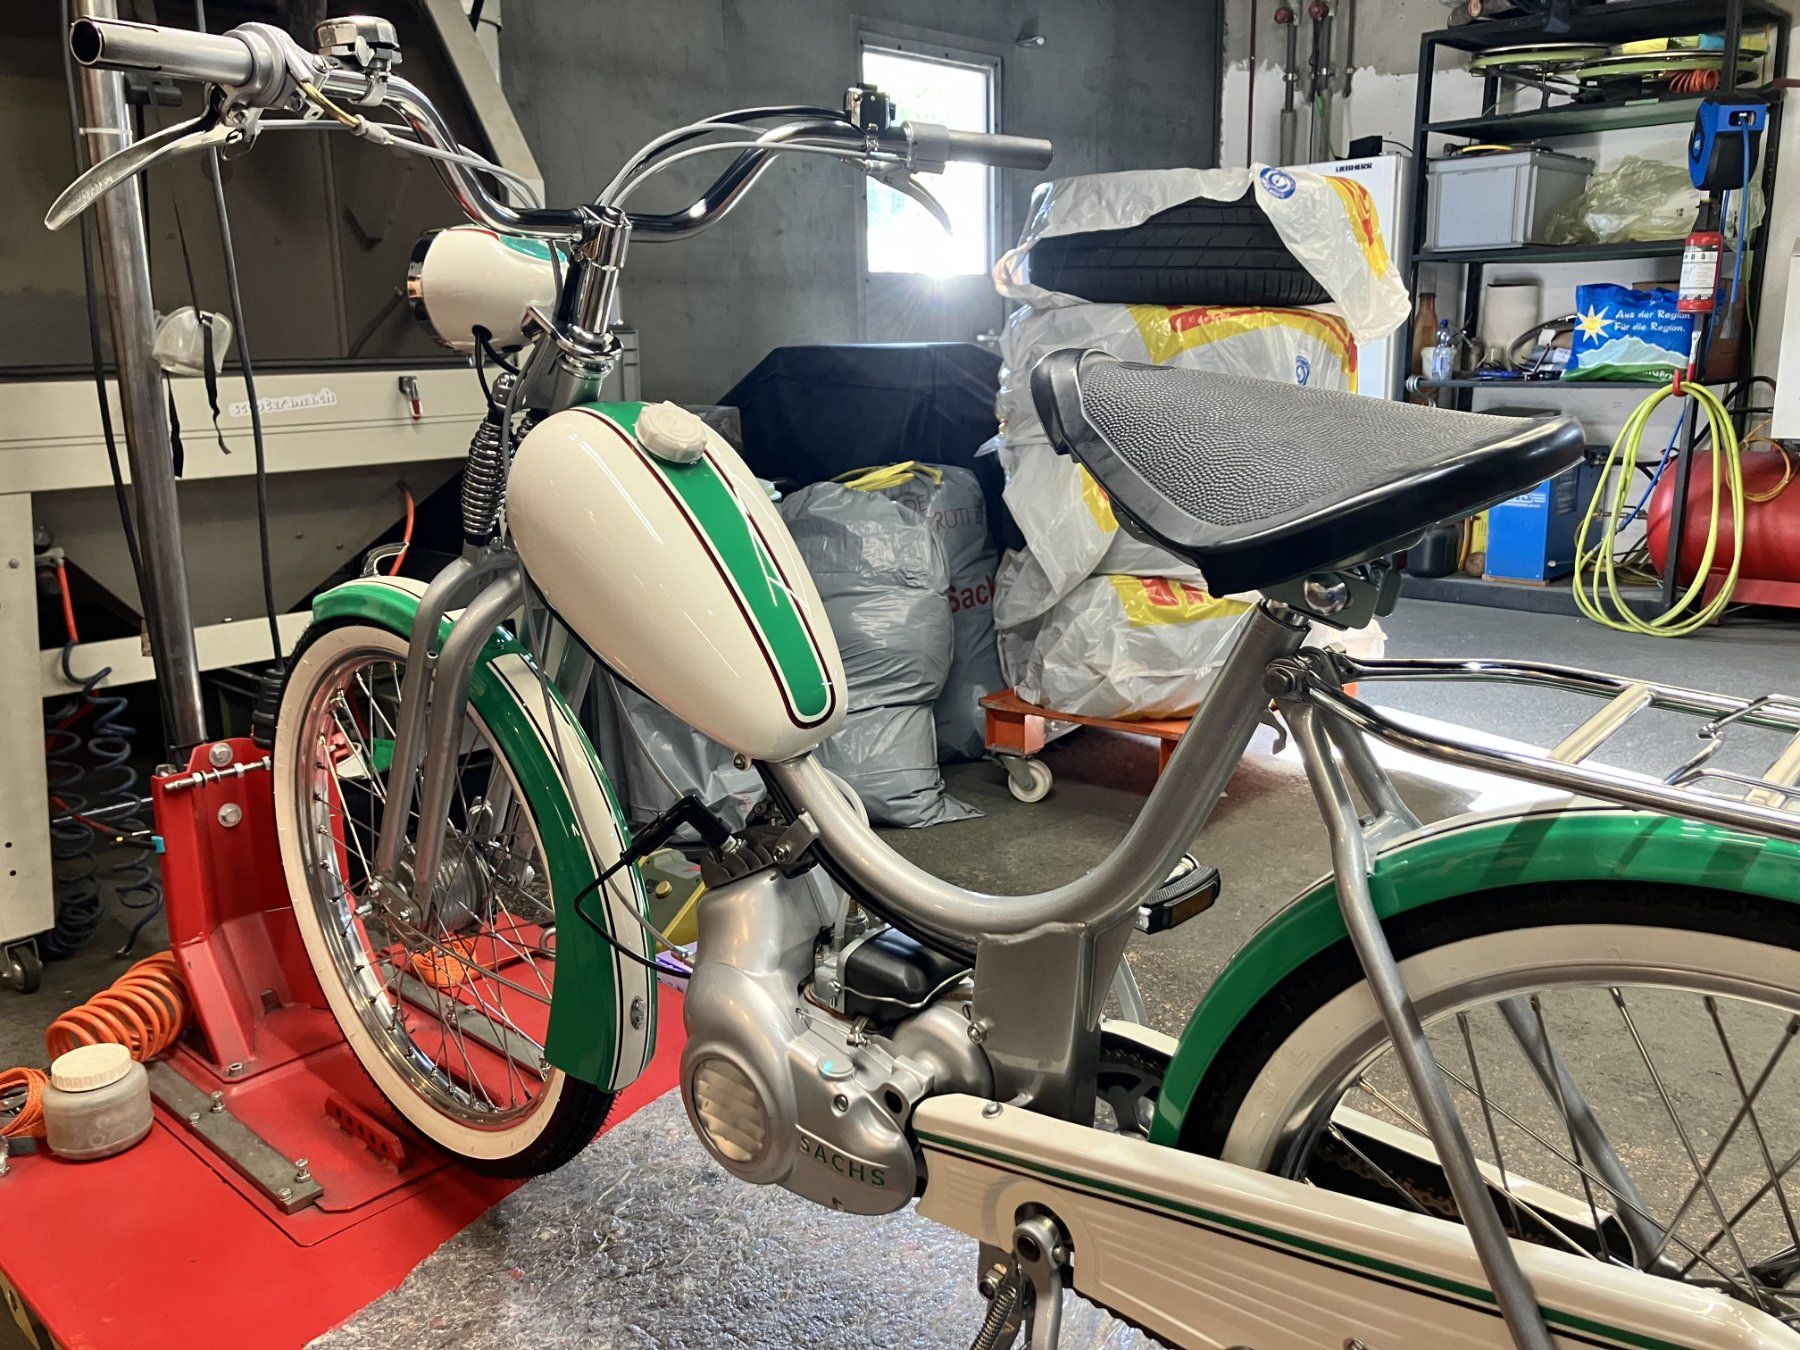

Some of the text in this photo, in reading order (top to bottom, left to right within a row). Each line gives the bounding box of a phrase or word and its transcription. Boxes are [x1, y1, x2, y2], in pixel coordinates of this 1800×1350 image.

[1615, 309, 1635, 319] Aus
[1637, 309, 1654, 319] der
[1614, 321, 1686, 333] Für die Region.
[799, 1135, 886, 1187] SACHS
